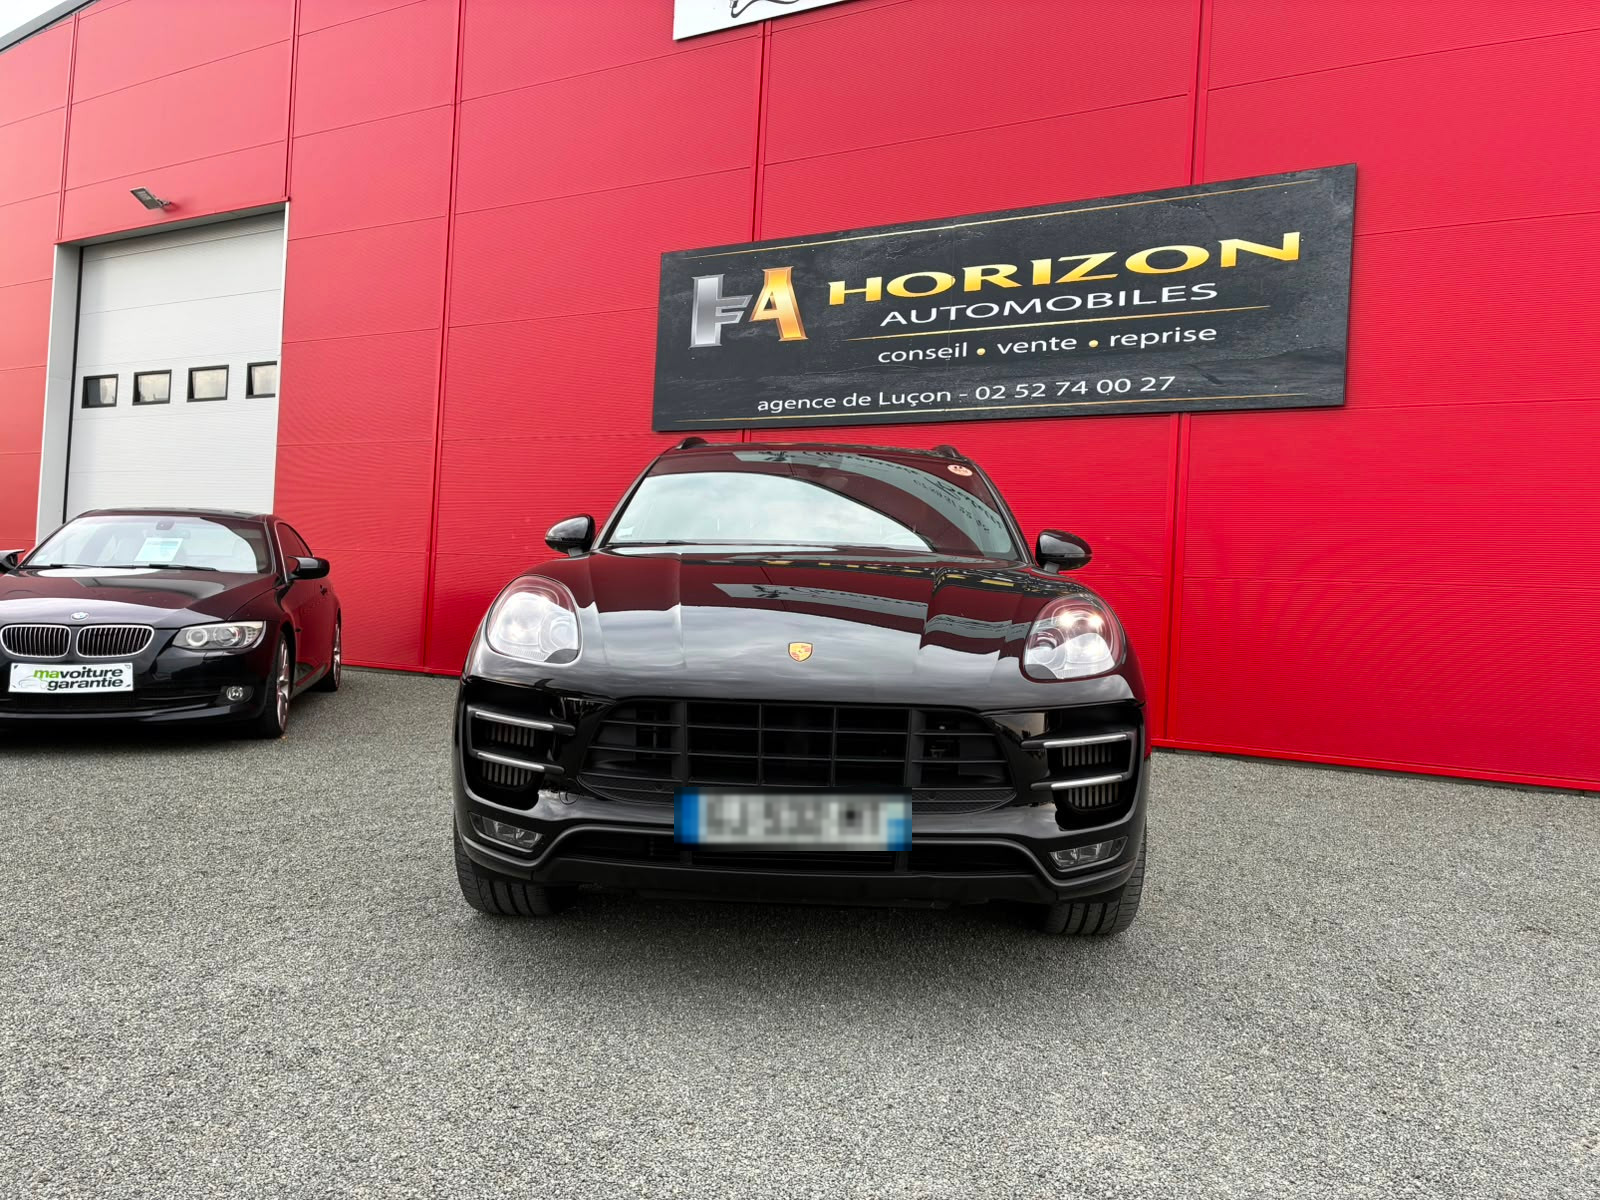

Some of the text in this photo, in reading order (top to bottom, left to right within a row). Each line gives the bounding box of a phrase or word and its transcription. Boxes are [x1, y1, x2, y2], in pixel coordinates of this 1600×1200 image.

[828, 231, 1301, 306] HORIZON
[879, 282, 1219, 328] AUTOMOBILES
[877, 324, 1219, 364] conseil vente reprise
[757, 397, 837, 414] agence
[842, 391, 872, 408] de
[878, 387, 952, 411] Luçon
[974, 384, 1009, 401] 02
[1013, 382, 1047, 400] 52
[1055, 380, 1090, 398] 74
[1096, 377, 1132, 396] 00
[1139, 375, 1177, 394] 27
[33, 666, 124, 680] mavoiture
[47, 677, 124, 692] garantie
